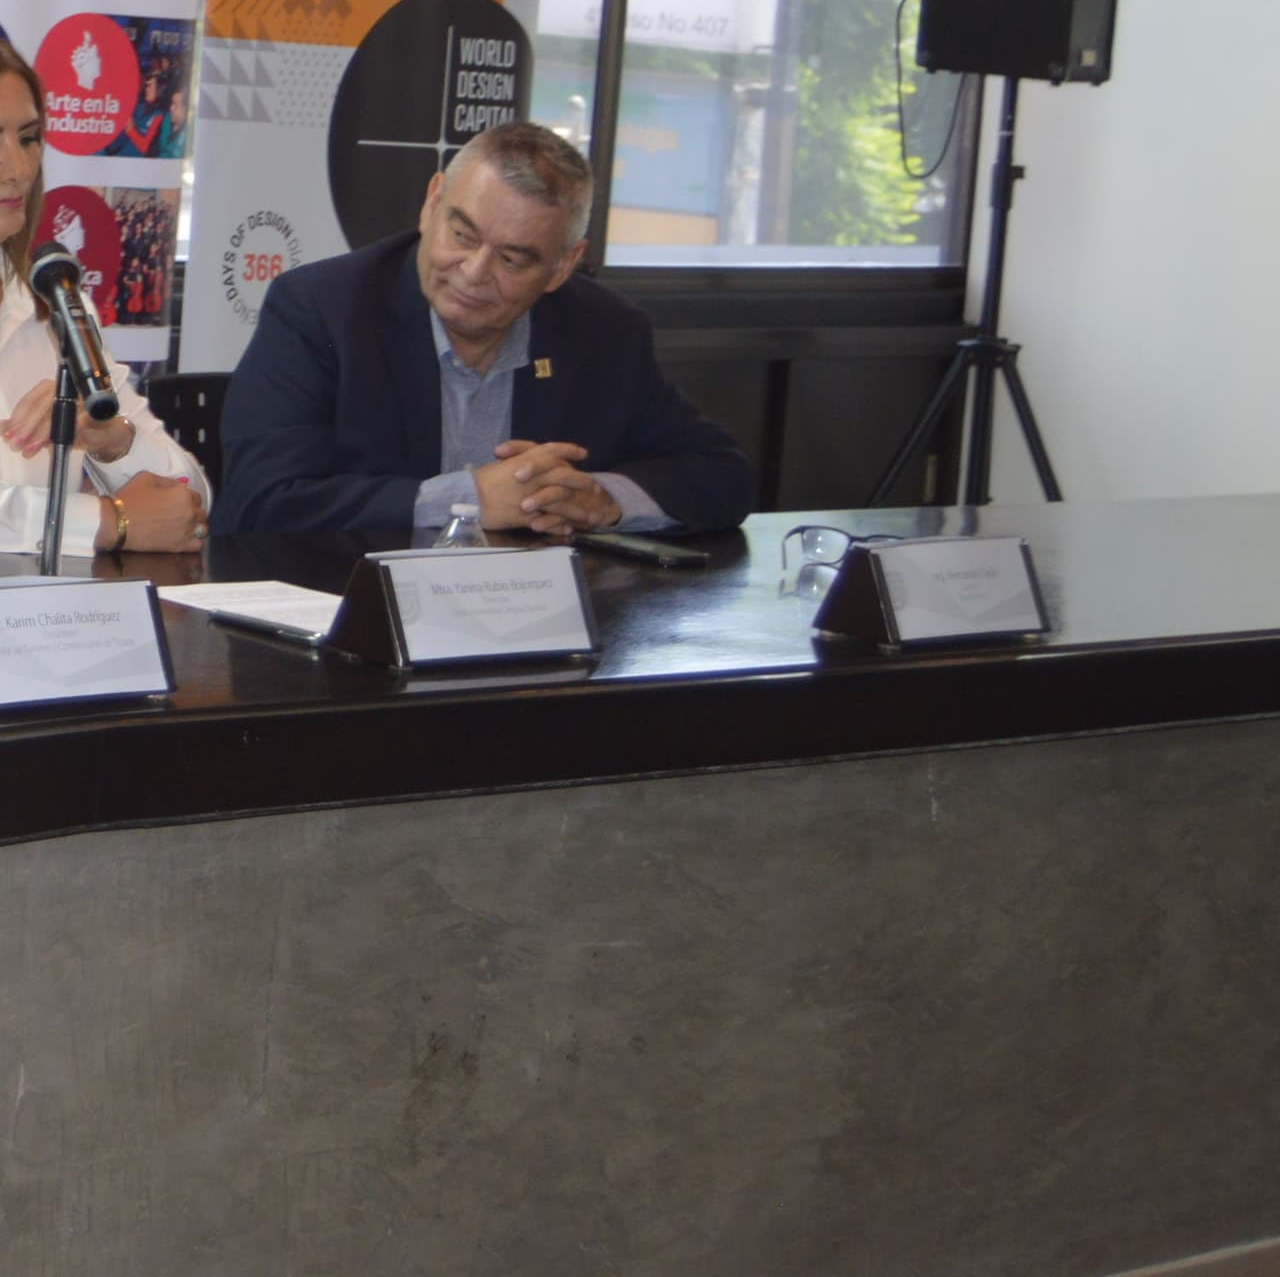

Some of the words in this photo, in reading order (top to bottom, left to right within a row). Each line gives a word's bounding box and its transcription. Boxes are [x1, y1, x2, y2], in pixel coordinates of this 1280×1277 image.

[458, 37, 517, 69] WORLD
[455, 71, 516, 101] DESIGN
[45, 92, 81, 112] Arte
[83, 98, 103, 113] en
[105, 94, 120, 114] la
[222, 250, 239, 301] DAYS
[247, 211, 293, 240] DESIGN
[243, 252, 284, 282] 366
